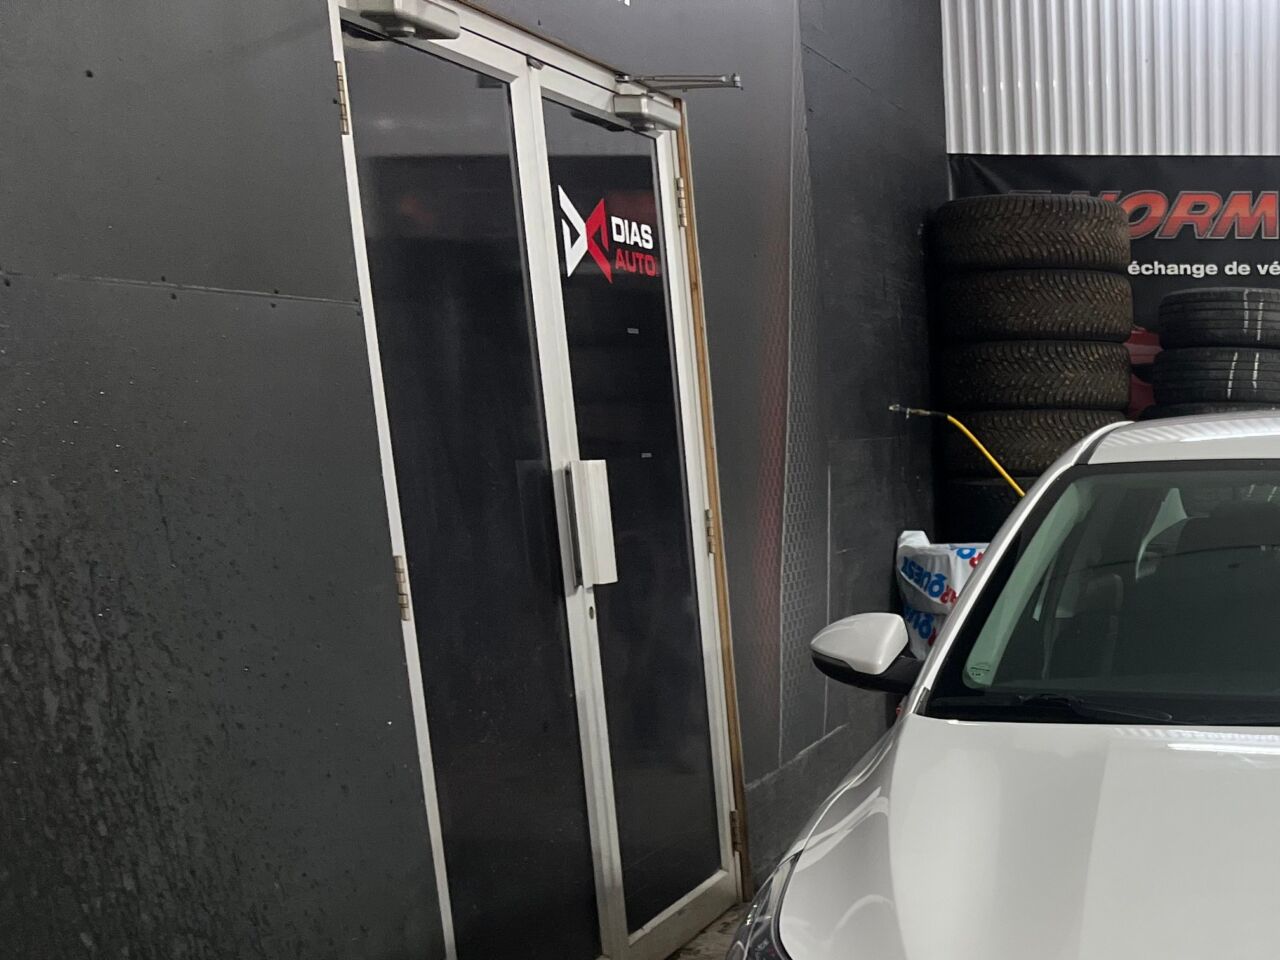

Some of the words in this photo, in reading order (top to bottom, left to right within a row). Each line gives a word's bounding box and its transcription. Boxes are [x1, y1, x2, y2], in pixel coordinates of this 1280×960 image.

[611, 216, 653, 249] DIAS
[616, 249, 656, 277] AUTO
[1127, 261, 1218, 278] échange
[1224, 261, 1250, 275] de
